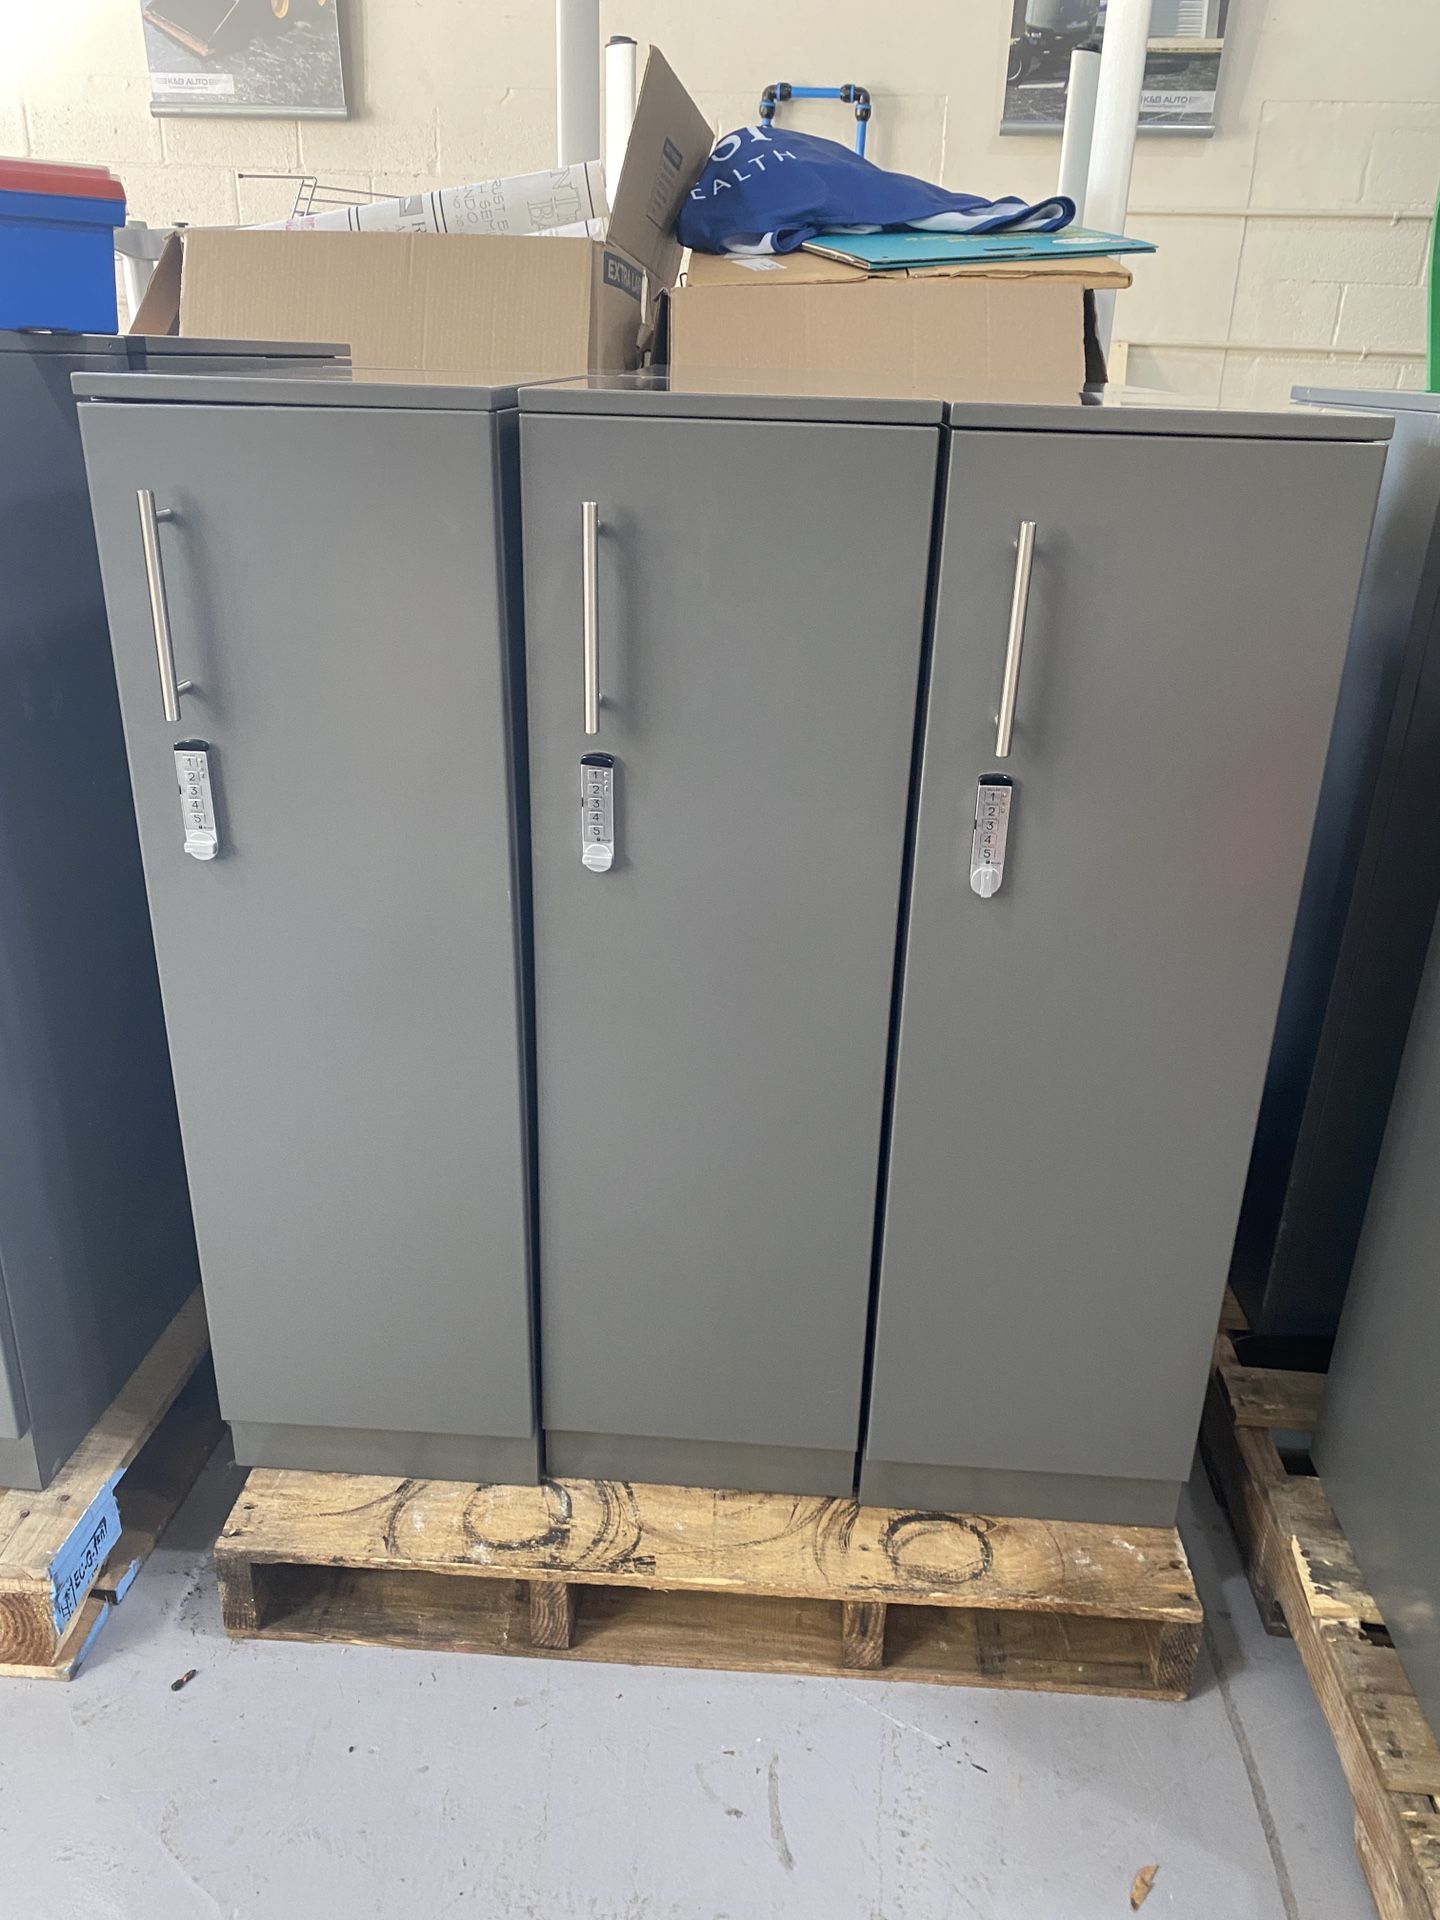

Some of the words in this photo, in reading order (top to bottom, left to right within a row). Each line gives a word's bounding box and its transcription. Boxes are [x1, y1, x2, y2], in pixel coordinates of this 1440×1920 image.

[186, 77, 209, 86] AUTO
[1163, 95, 1189, 104] AUTO
[690, 149, 797, 200] EALTH
[188, 771, 196, 782] 2
[190, 786, 198, 796] 3
[592, 784, 600, 795] 2
[191, 800, 199, 810] 4
[592, 799, 600, 809] 3
[987, 806, 996, 817] 2
[194, 814, 202, 824] 5
[592, 813, 600, 822] 4
[986, 820, 994, 831] 3
[592, 826, 601, 836] 5
[984, 835, 992, 845] 4
[983, 849, 991, 859] 5
